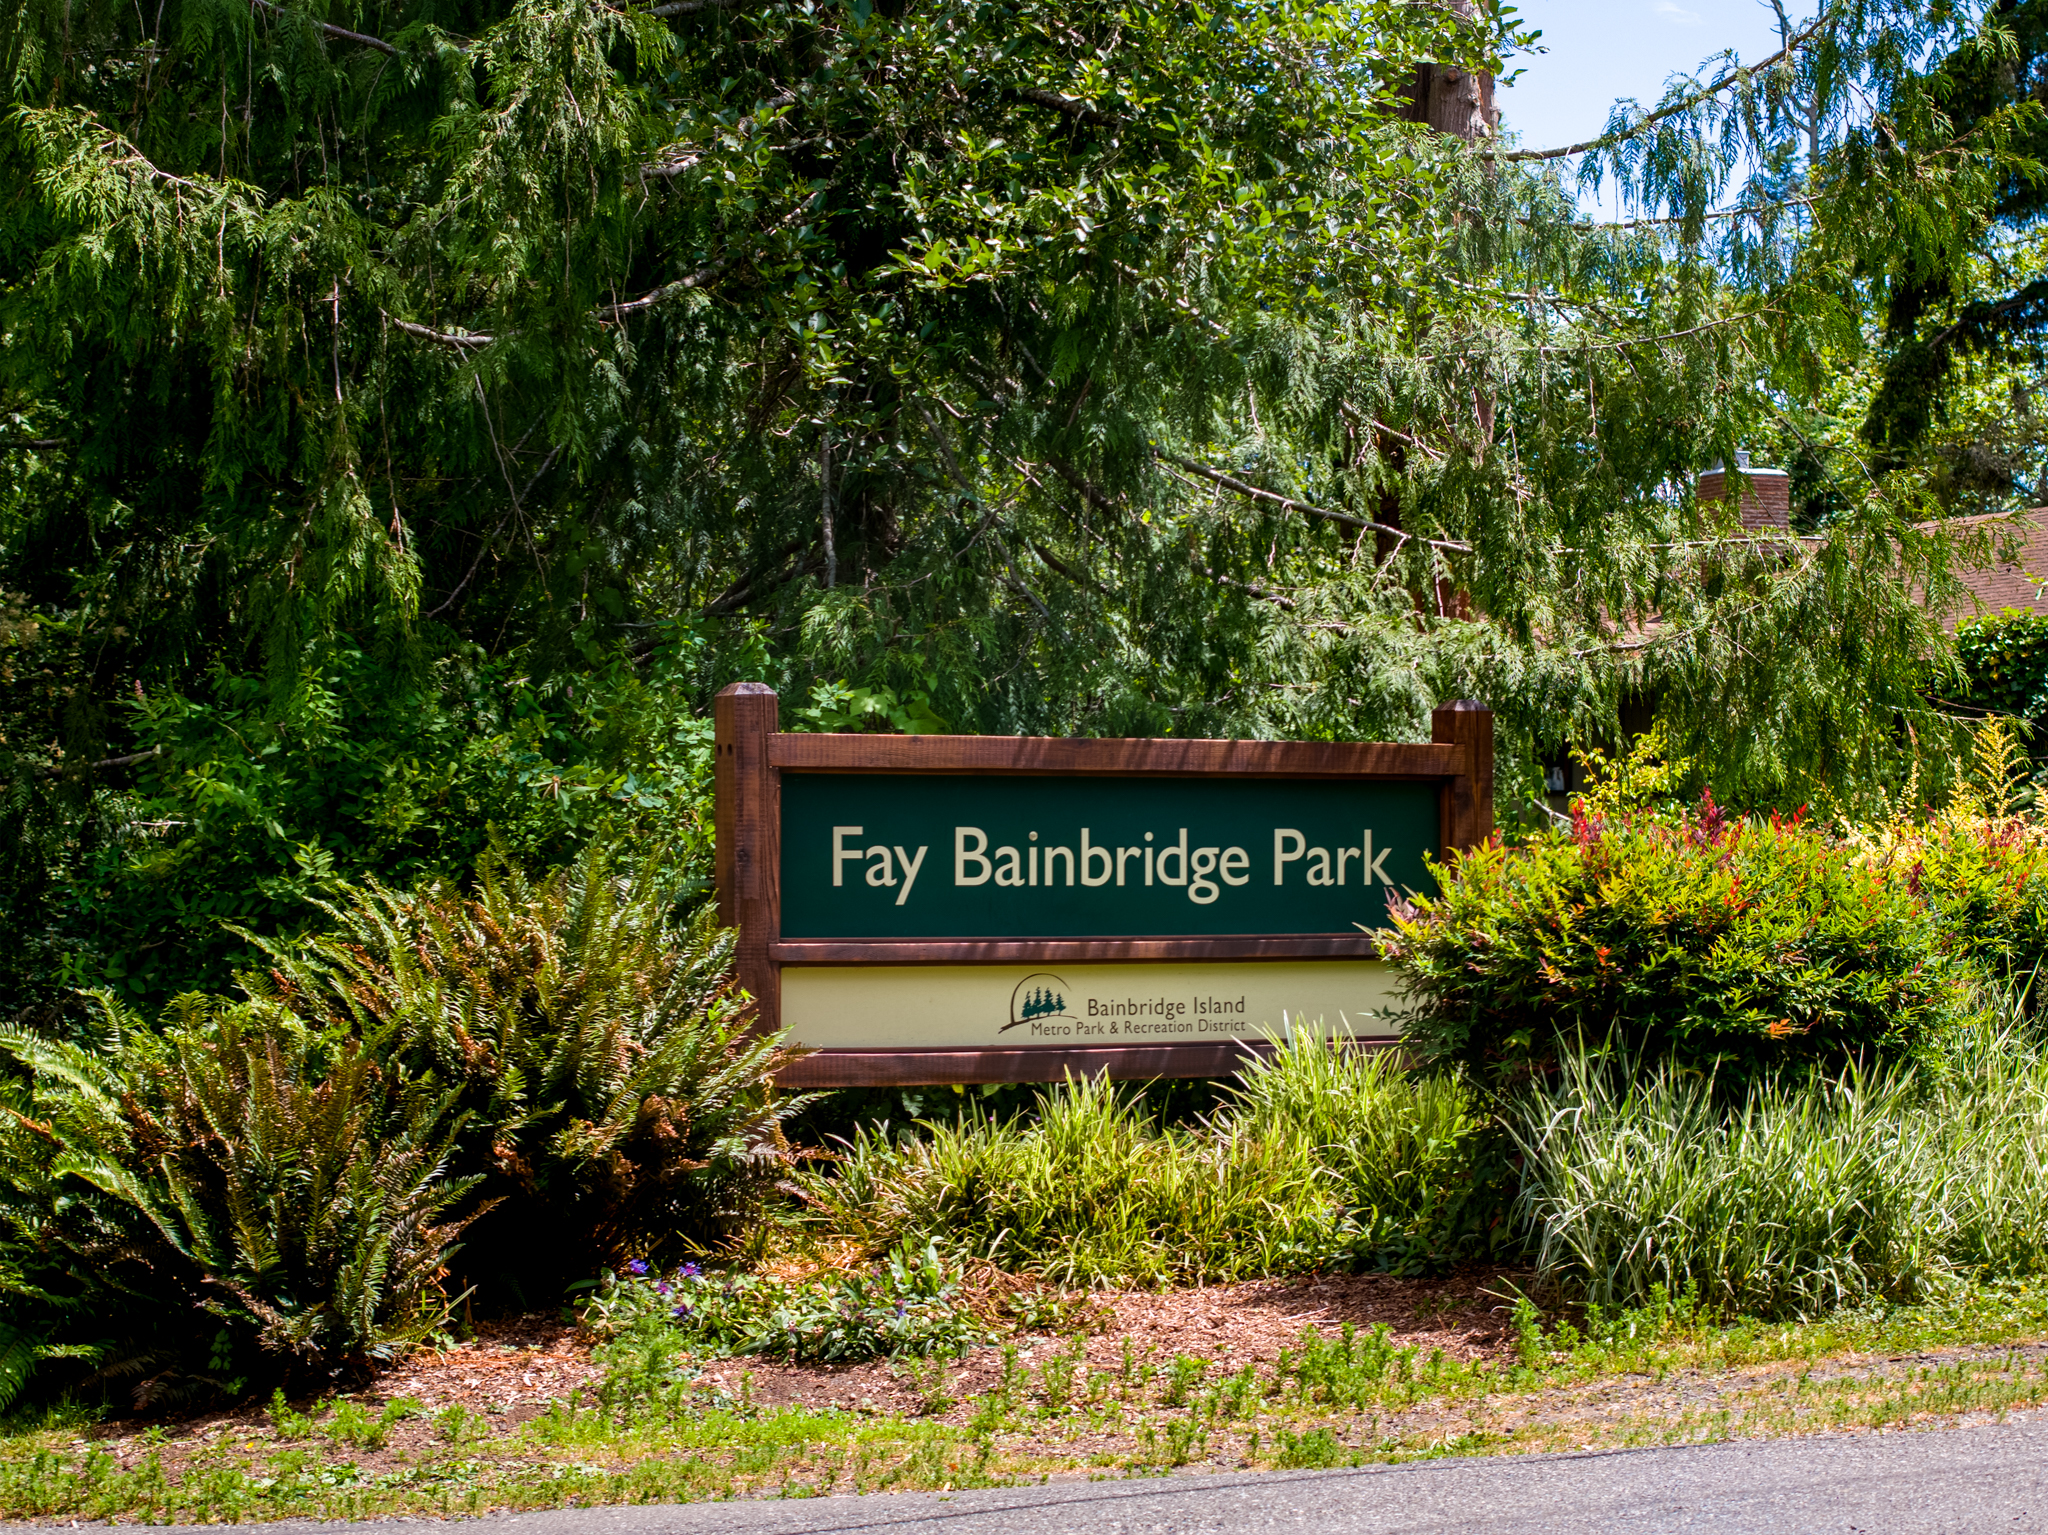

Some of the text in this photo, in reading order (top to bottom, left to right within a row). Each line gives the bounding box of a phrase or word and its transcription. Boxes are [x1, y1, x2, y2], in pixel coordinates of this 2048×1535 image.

[832, 825, 1395, 906] Fay Bainbridge Park
[1087, 995, 1246, 1020] Bainbridge Island
[1031, 1018, 1246, 1037] Metro Park & Recreation District
